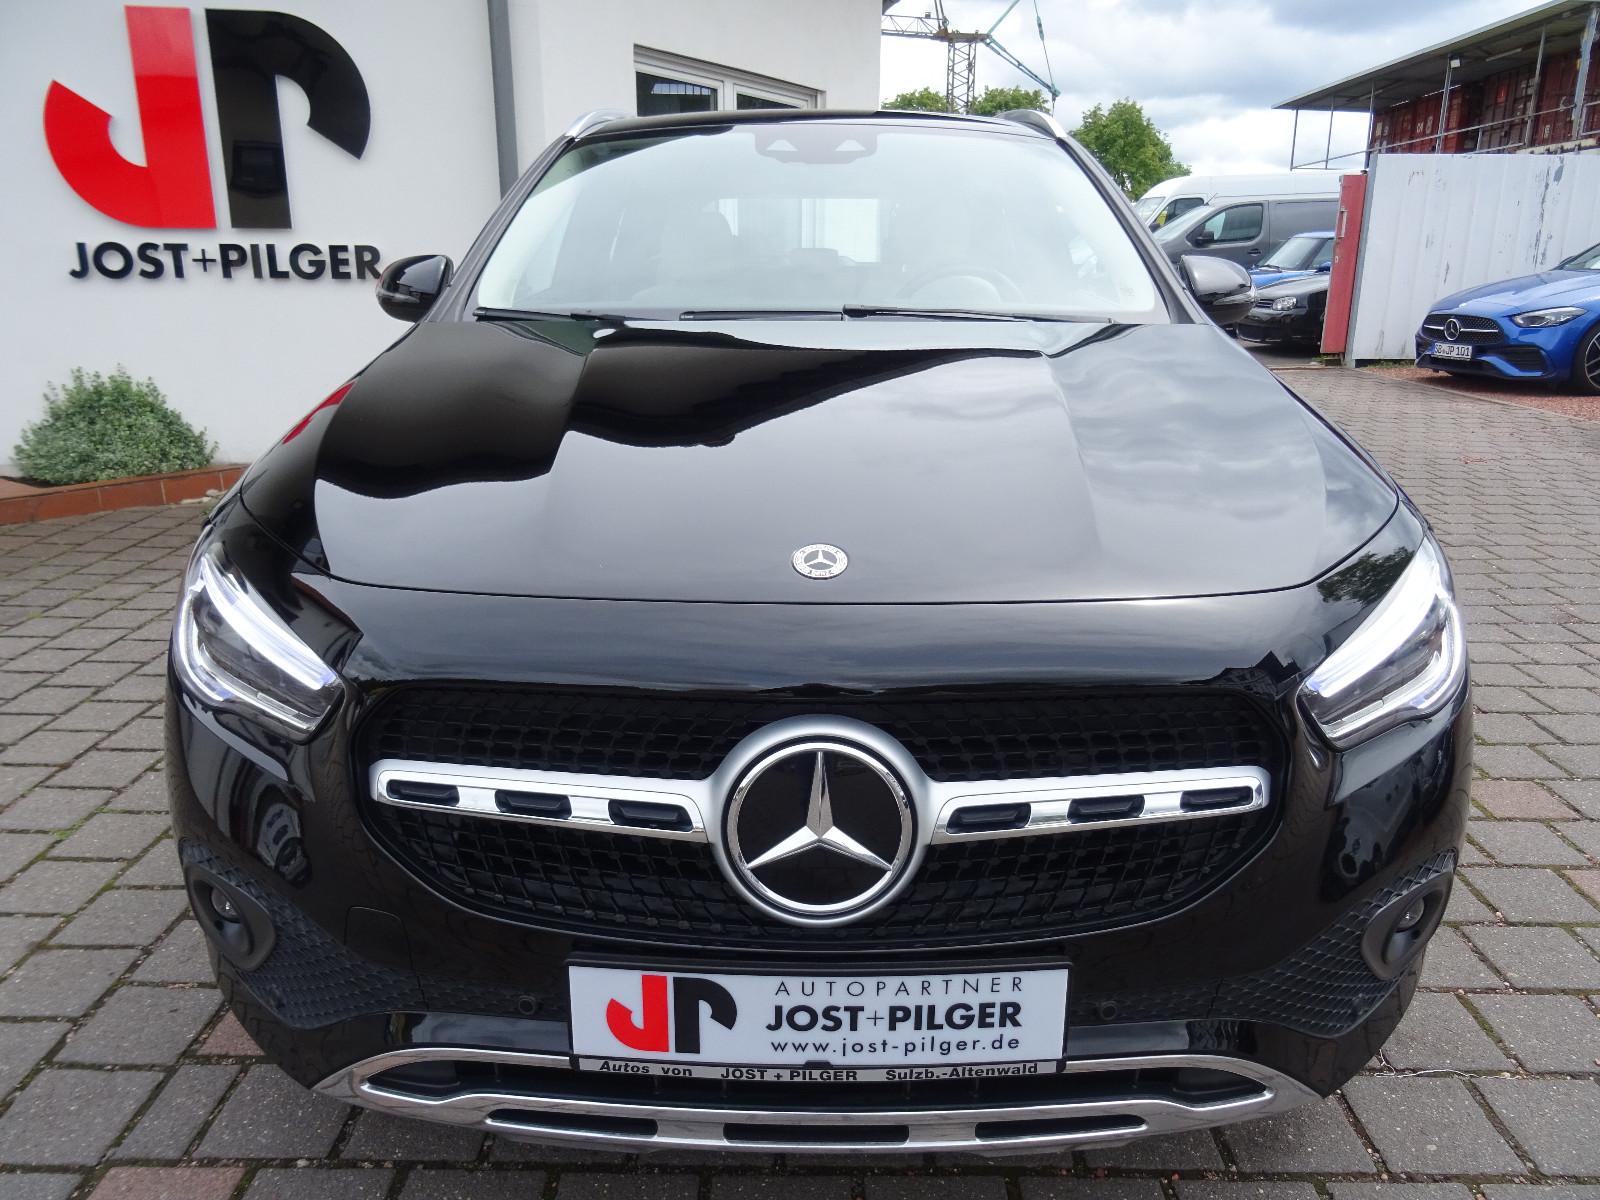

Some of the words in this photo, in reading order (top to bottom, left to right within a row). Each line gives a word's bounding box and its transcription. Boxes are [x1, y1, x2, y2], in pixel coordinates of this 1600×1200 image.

[69, 241, 382, 280] JOST+PILGER
[775, 977, 1022, 997] AUTOPARTNER
[766, 1001, 1022, 1032] JOST+PILGER
[771, 1034, 1020, 1057] www.jost-pilger.de
[600, 1060, 650, 1074] Autos
[661, 1066, 693, 1077] von
[721, 1067, 767, 1080] JOST
[790, 1069, 858, 1081] PILGER
[885, 1063, 1038, 1081] Sulzb.-Altenwald
